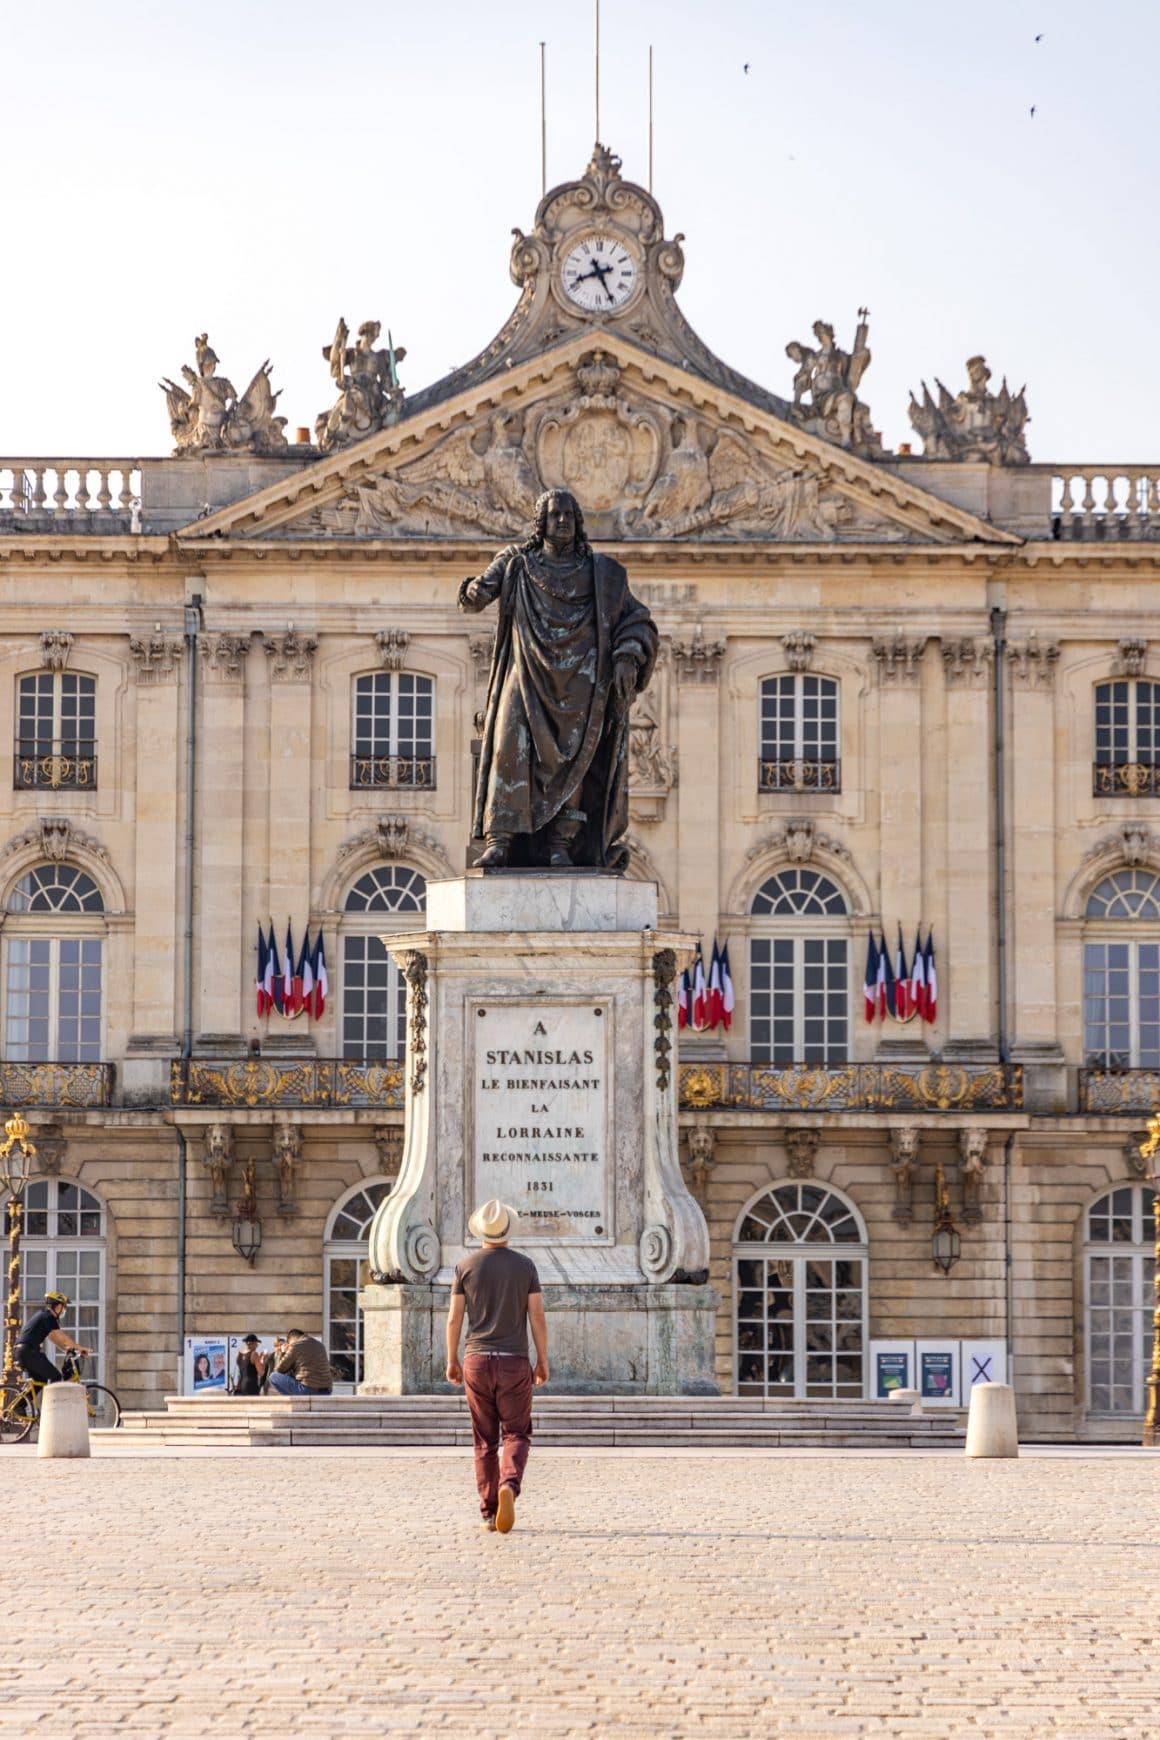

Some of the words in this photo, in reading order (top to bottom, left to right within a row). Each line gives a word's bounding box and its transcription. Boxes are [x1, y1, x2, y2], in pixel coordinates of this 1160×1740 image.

[533, 1021, 548, 1035] A
[486, 1050, 594, 1065] STANISLAS
[481, 1079, 500, 1090] LE
[506, 1079, 601, 1090] BIENFAISANT
[531, 1103, 549, 1113] LA
[496, 1127, 585, 1139] LORRAINE
[482, 1152, 599, 1163] RECONNAISSANTE
[187, 1339, 192, 1349] 1
[231, 1338, 238, 1348] 2
